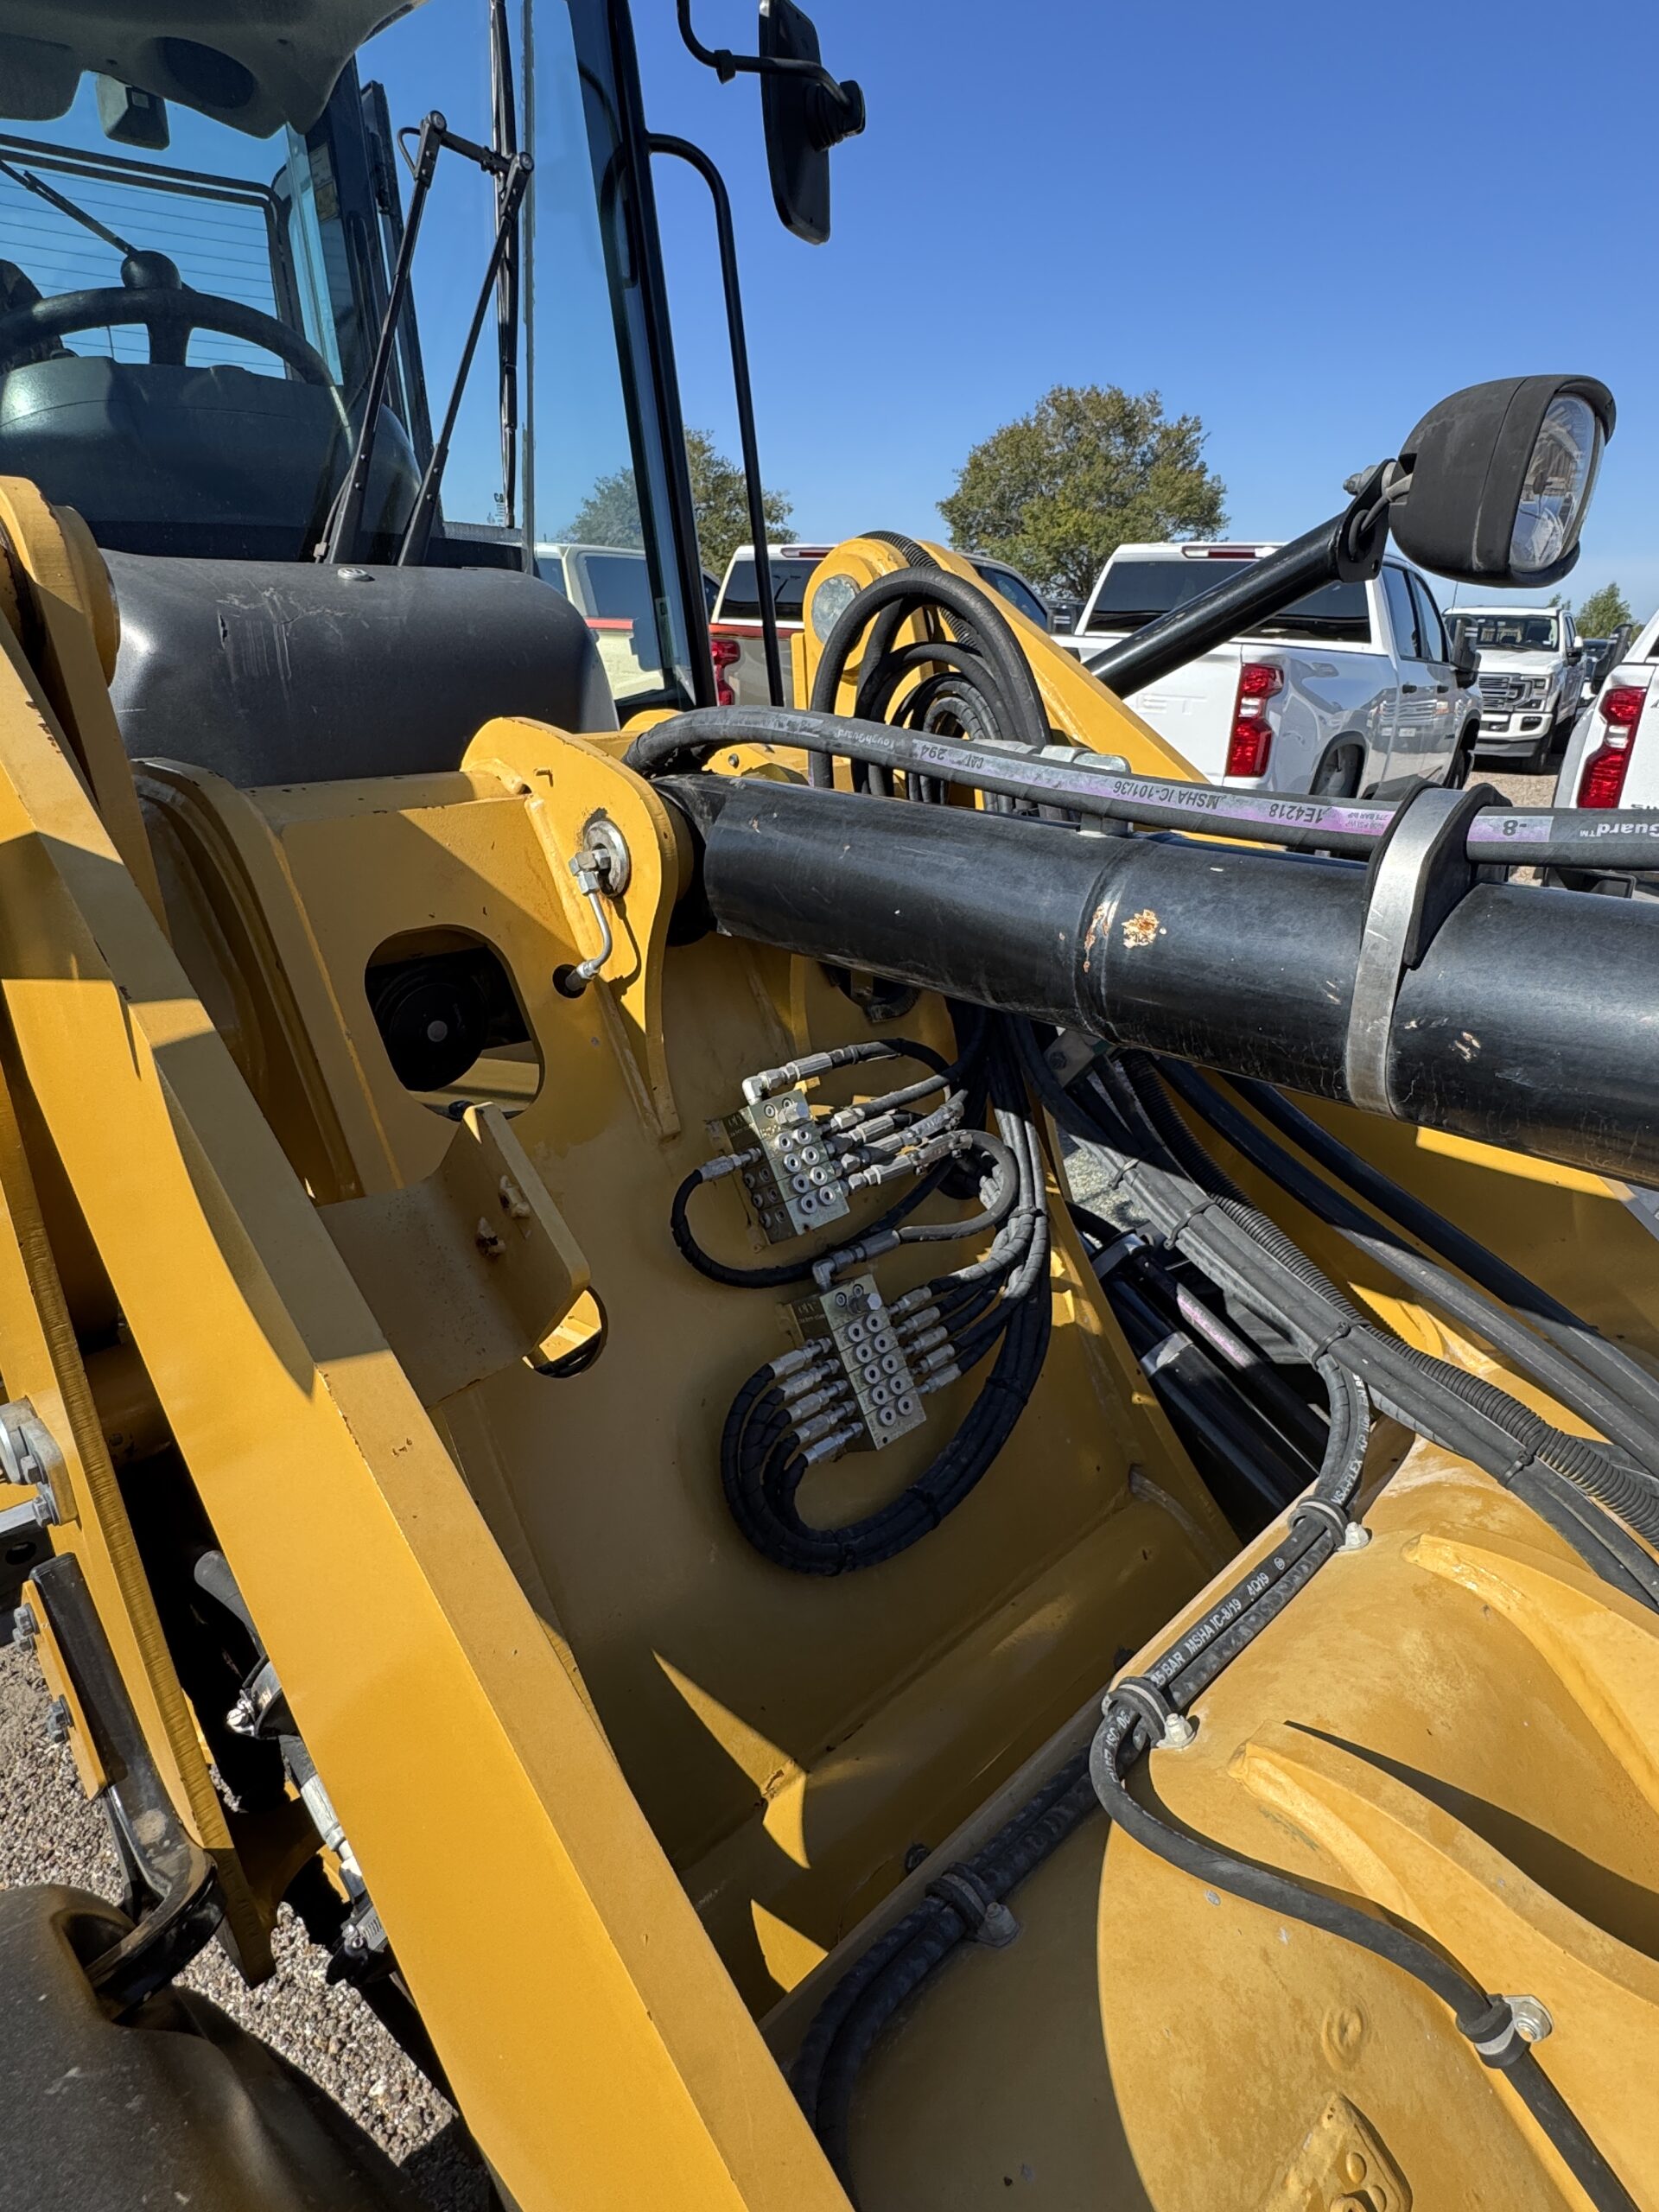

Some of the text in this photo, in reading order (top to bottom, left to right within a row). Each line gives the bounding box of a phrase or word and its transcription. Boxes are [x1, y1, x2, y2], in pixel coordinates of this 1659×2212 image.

[920, 744, 948, 760] 294
[1178, 790, 1221, 810] MSHA
[1268, 803, 1324, 824] 1E4218
[1502, 819, 1527, 836] -8
[1161, 1651, 1186, 1676] BAR
[1183, 1623, 1214, 1656] MSHA
[1210, 1598, 1243, 1630] IC-8/19
